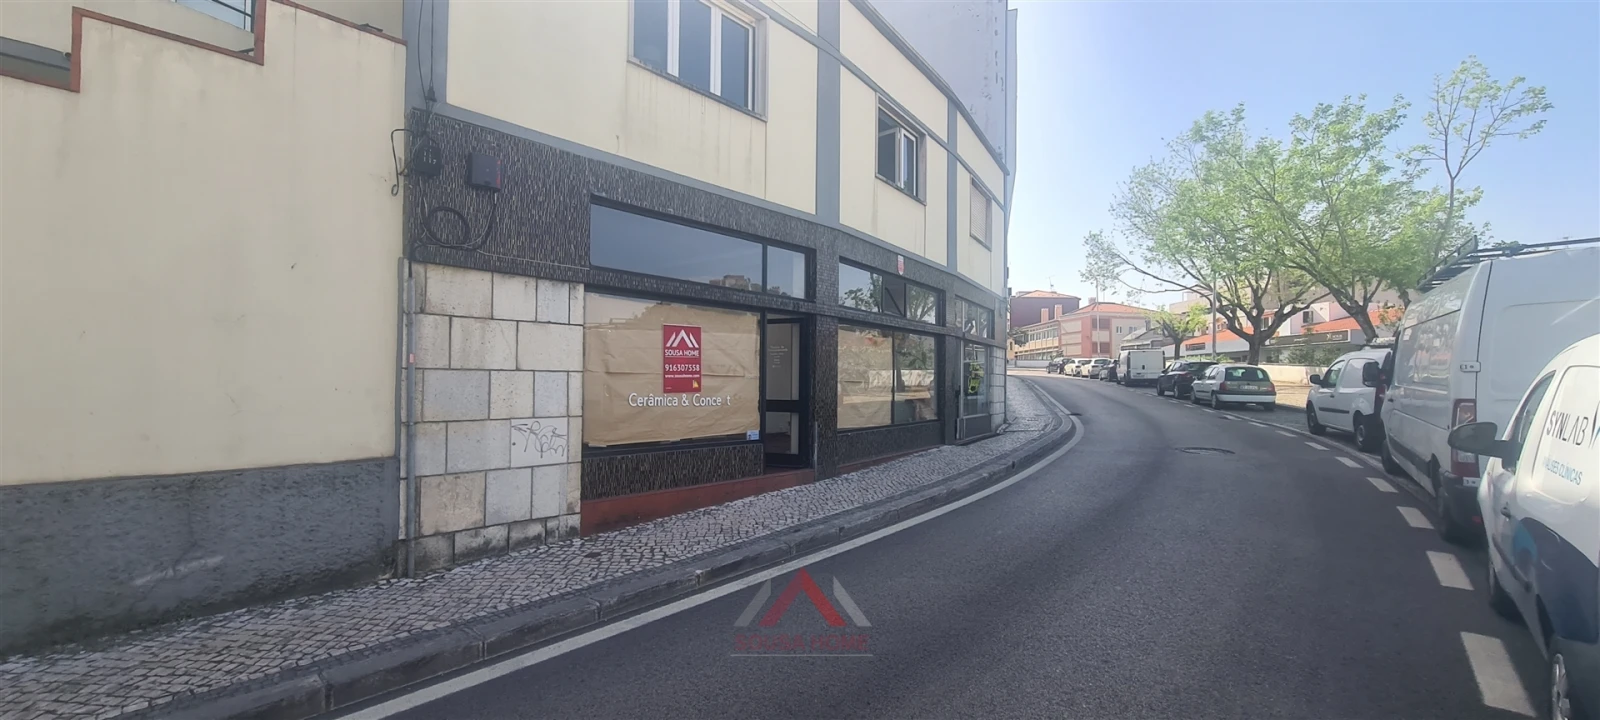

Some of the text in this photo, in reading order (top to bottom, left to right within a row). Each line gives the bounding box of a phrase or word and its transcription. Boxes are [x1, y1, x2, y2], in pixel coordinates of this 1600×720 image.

[664, 364, 700, 372] 916307558
[628, 392, 678, 407] Cerâmica
[681, 393, 689, 406] &
[1546, 410, 1589, 446] SYNLAB
